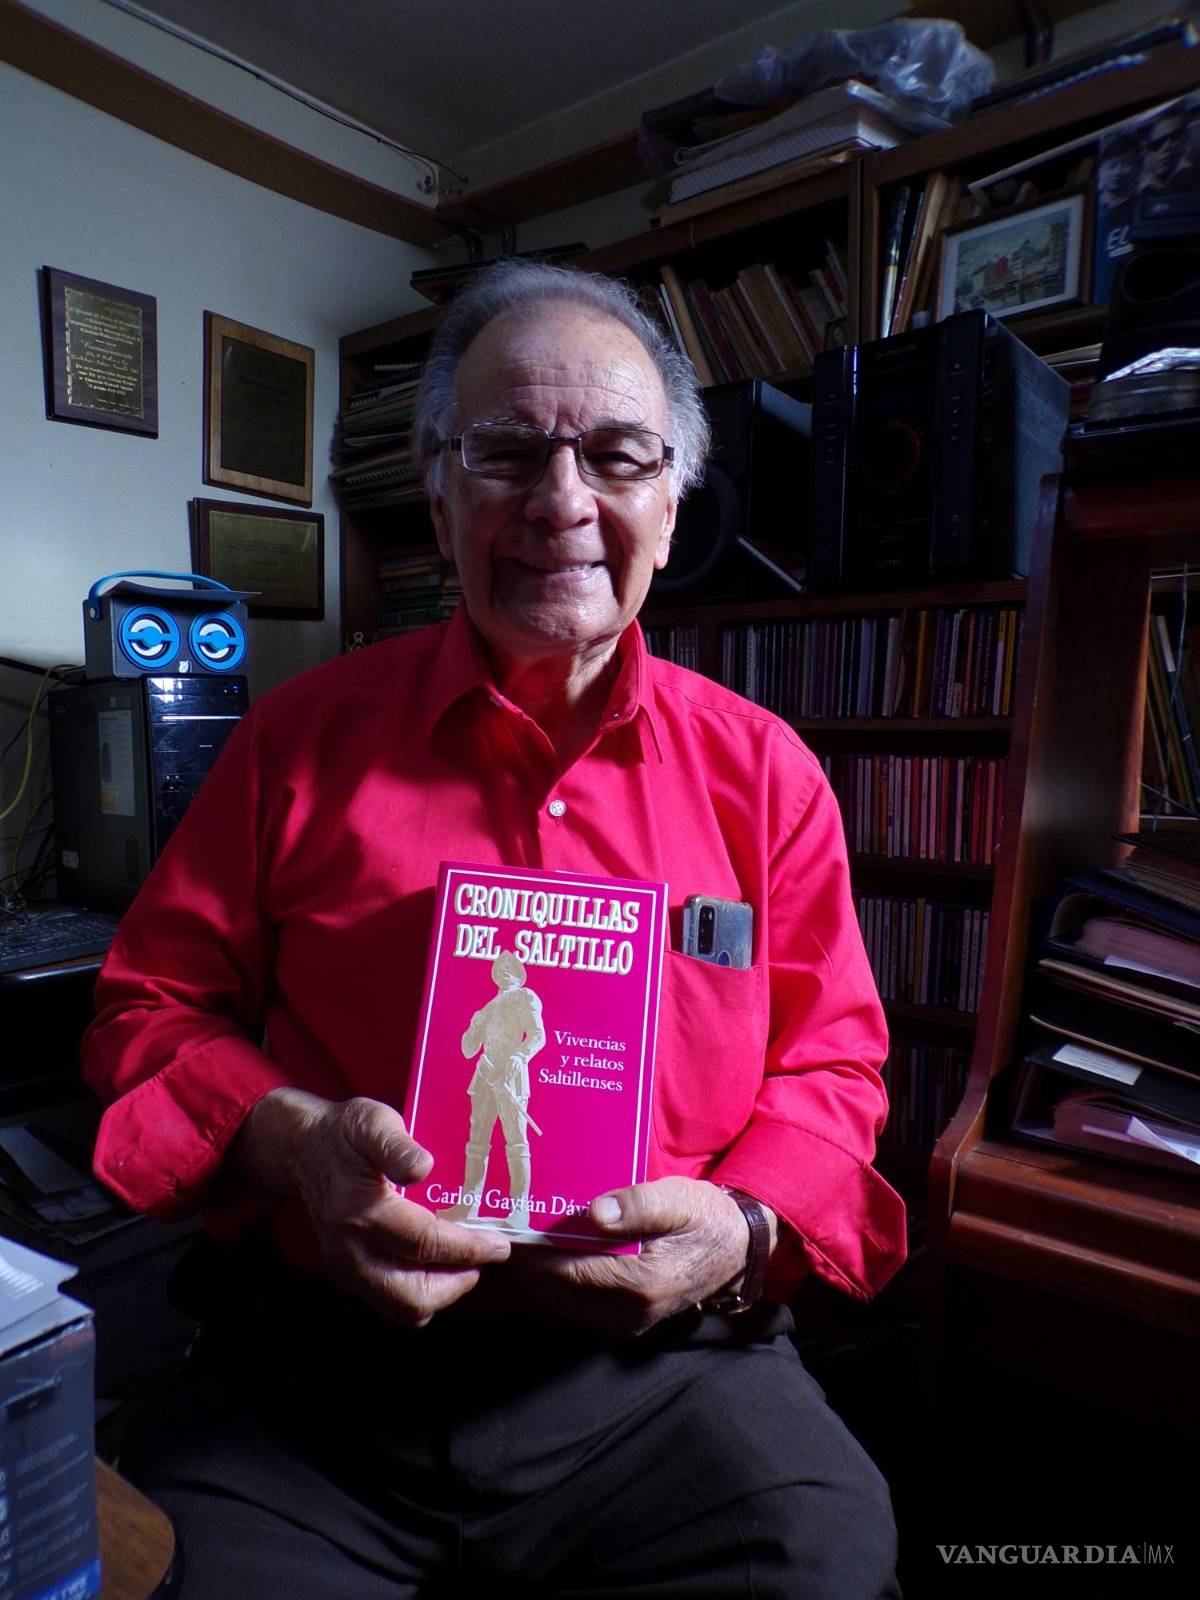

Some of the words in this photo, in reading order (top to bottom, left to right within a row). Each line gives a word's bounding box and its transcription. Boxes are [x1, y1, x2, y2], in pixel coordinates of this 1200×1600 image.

[455, 883, 640, 933] CRONIQUILLAS
[453, 923, 501, 960] DEL
[515, 930, 634, 975] SALTILLO
[554, 1030, 626, 1052] Vivencias
[560, 1054, 570, 1067] y
[573, 1053, 625, 1071] relatos
[538, 1068, 623, 1091] Saltillenses
[426, 1184, 481, 1206] Carlos
[485, 1189, 546, 1216] Gaytán
[551, 1196, 591, 1217] Dávi
